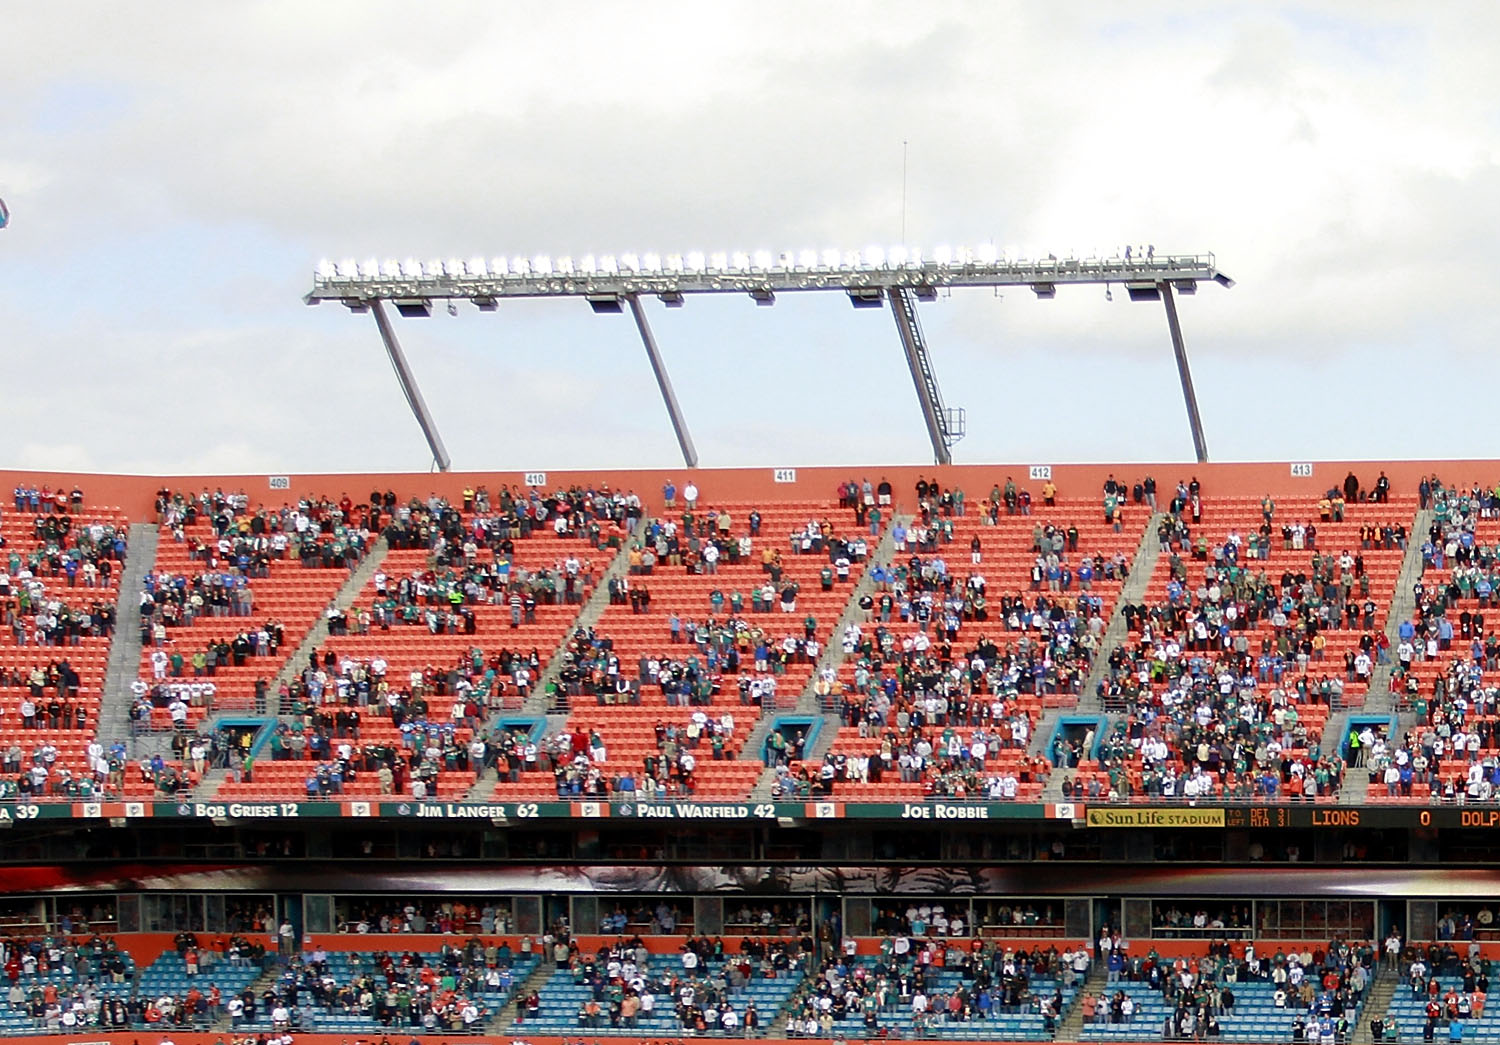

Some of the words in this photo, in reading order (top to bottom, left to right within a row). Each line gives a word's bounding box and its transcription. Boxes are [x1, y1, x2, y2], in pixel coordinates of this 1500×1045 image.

[776, 471, 793, 480] 411
[1032, 468, 1049, 477] 412
[1293, 465, 1311, 475] 413
[271, 478, 288, 487] 409
[527, 475, 544, 484] 410
[16, 805, 39, 819] 39
[196, 804, 226, 817] BOB
[230, 804, 278, 817] GRIESE
[281, 804, 298, 817] 12
[416, 804, 443, 818] JIM
[447, 804, 506, 818] LANGER
[517, 804, 539, 818] 62
[637, 804, 674, 818] PAUL
[676, 804, 748, 818] WARFIELD
[754, 804, 776, 818] 42
[902, 804, 931, 819] JOE
[935, 804, 988, 819] ROBBIE
[1106, 811, 1134, 825] Sun
[1137, 811, 1164, 825] Life
[1168, 814, 1222, 825] STADIUM
[1312, 810, 1360, 826] LIONS
[1420, 811, 1431, 827] 0
